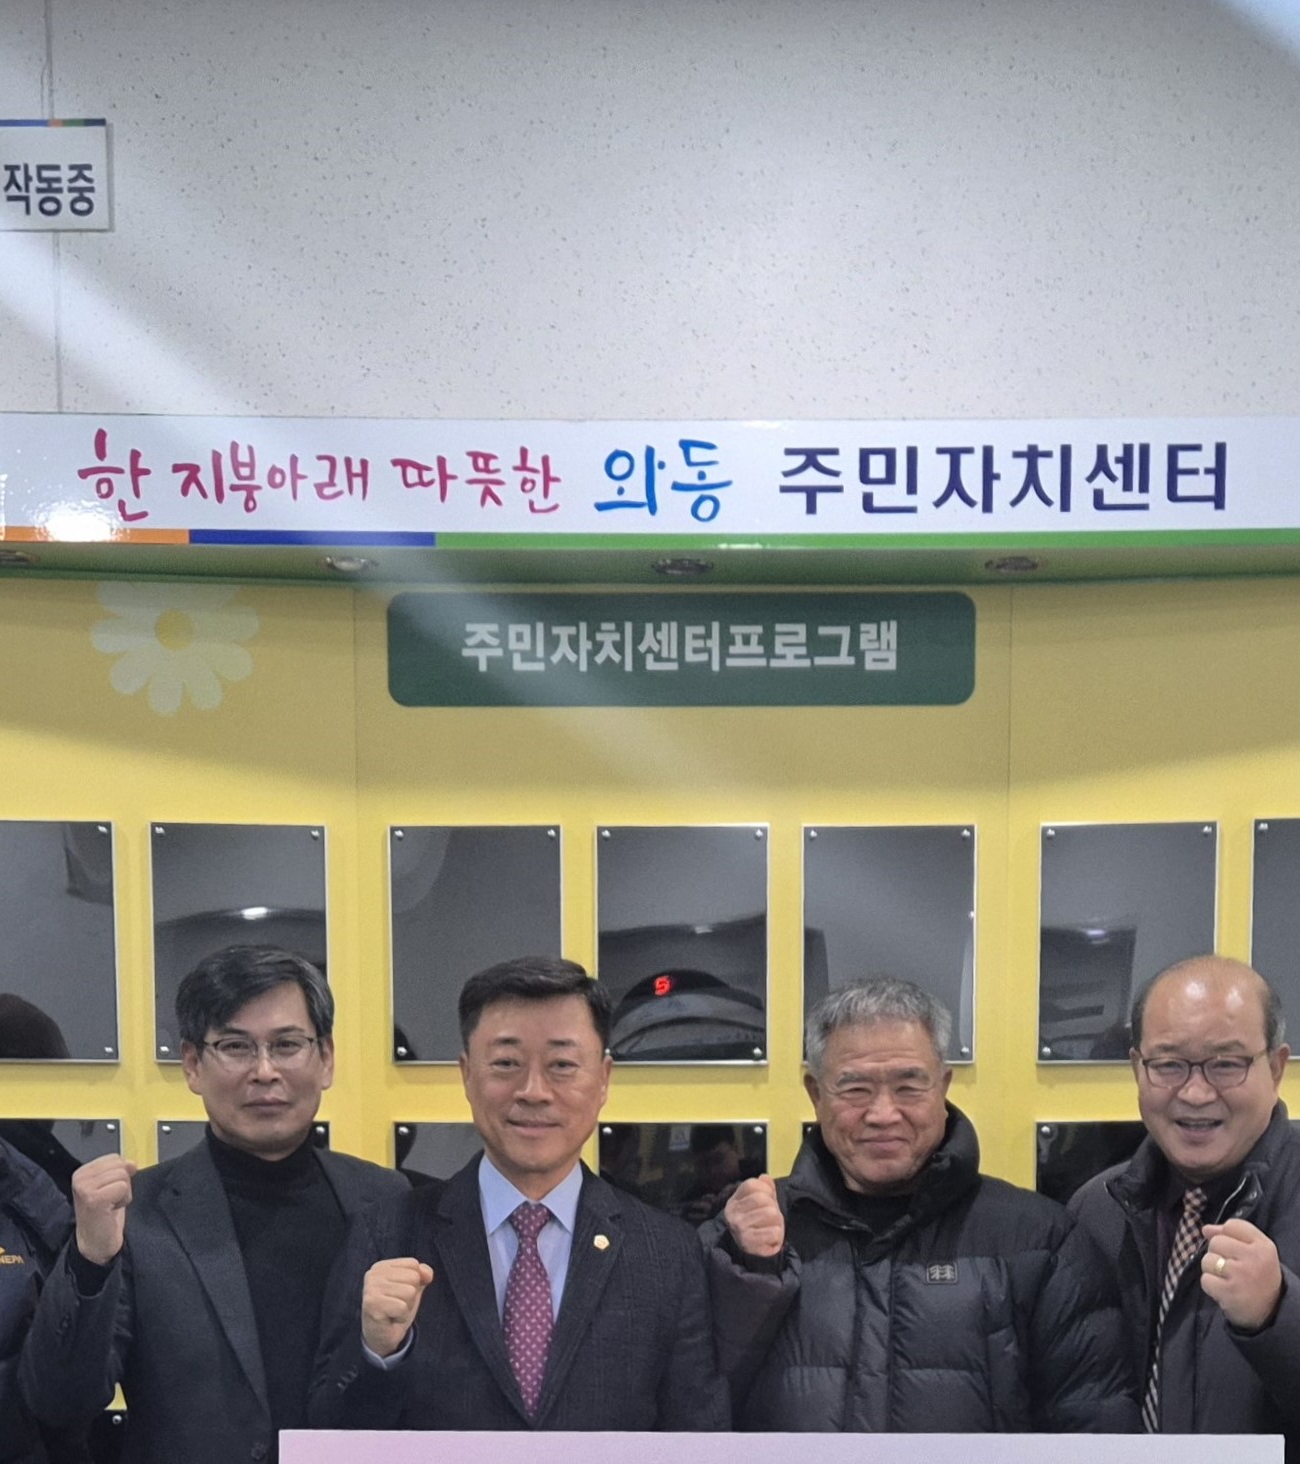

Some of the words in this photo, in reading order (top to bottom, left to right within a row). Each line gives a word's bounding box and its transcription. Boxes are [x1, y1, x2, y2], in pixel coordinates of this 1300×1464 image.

[77, 428, 152, 521] 한
[172, 440, 371, 516] 지붕아래
[391, 446, 562, 515] 따뜻한
[594, 438, 734, 523] 와동
[778, 441, 1230, 517] 주민자치센터
[463, 620, 897, 673] 주민자치센터프로그램
